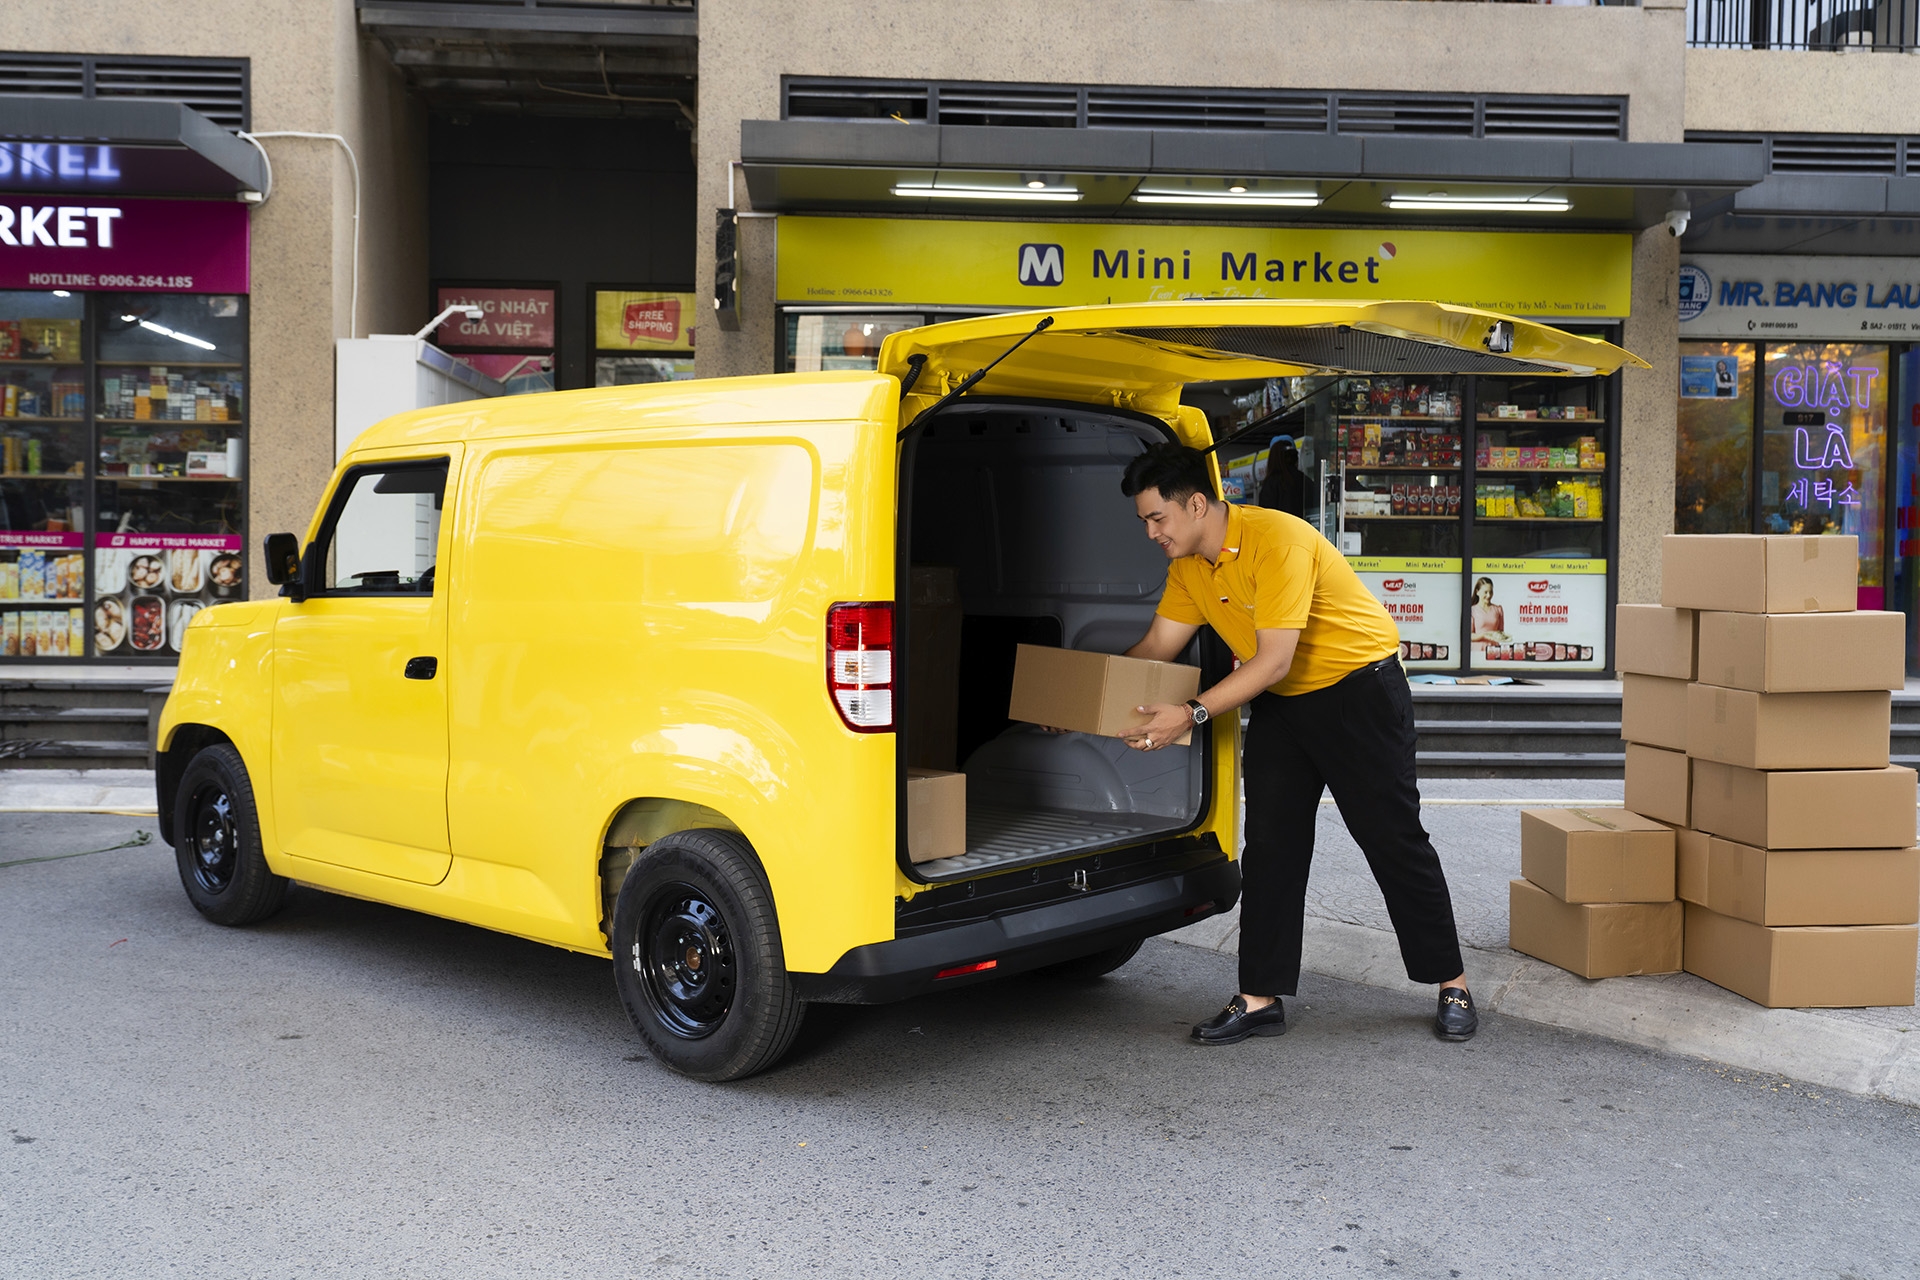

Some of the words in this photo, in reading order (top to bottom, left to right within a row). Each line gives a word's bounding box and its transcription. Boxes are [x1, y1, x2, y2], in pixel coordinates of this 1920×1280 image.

[0, 205, 123, 248] RKET
[1093, 248, 1191, 280] Mini
[1221, 251, 1380, 284] Market
[29, 273, 97, 286] HOTLINE:
[99, 275, 194, 288] 0906.264.185
[807, 287, 836, 296] Hotline
[500, 298, 549, 317] NHẬT
[1475, 301, 1498, 309] Smart
[1499, 301, 1515, 310] City
[1554, 302, 1573, 310] Nam
[639, 310, 664, 320] FREE
[460, 319, 490, 335] GIÁ
[494, 320, 534, 339] VIỆT
[628, 321, 673, 333] SHIPPING
[1774, 361, 1879, 416] GIẶT
[1794, 423, 1854, 469] LÀ
[1785, 477, 1861, 509] 세탁소
[25, 535, 64, 545] MARKET
[129, 537, 160, 546] HAPPY
[162, 537, 187, 547] TRUE
[188, 538, 227, 547] MARKET
[1400, 604, 1424, 614] NGON
[1545, 605, 1568, 615] NGON
